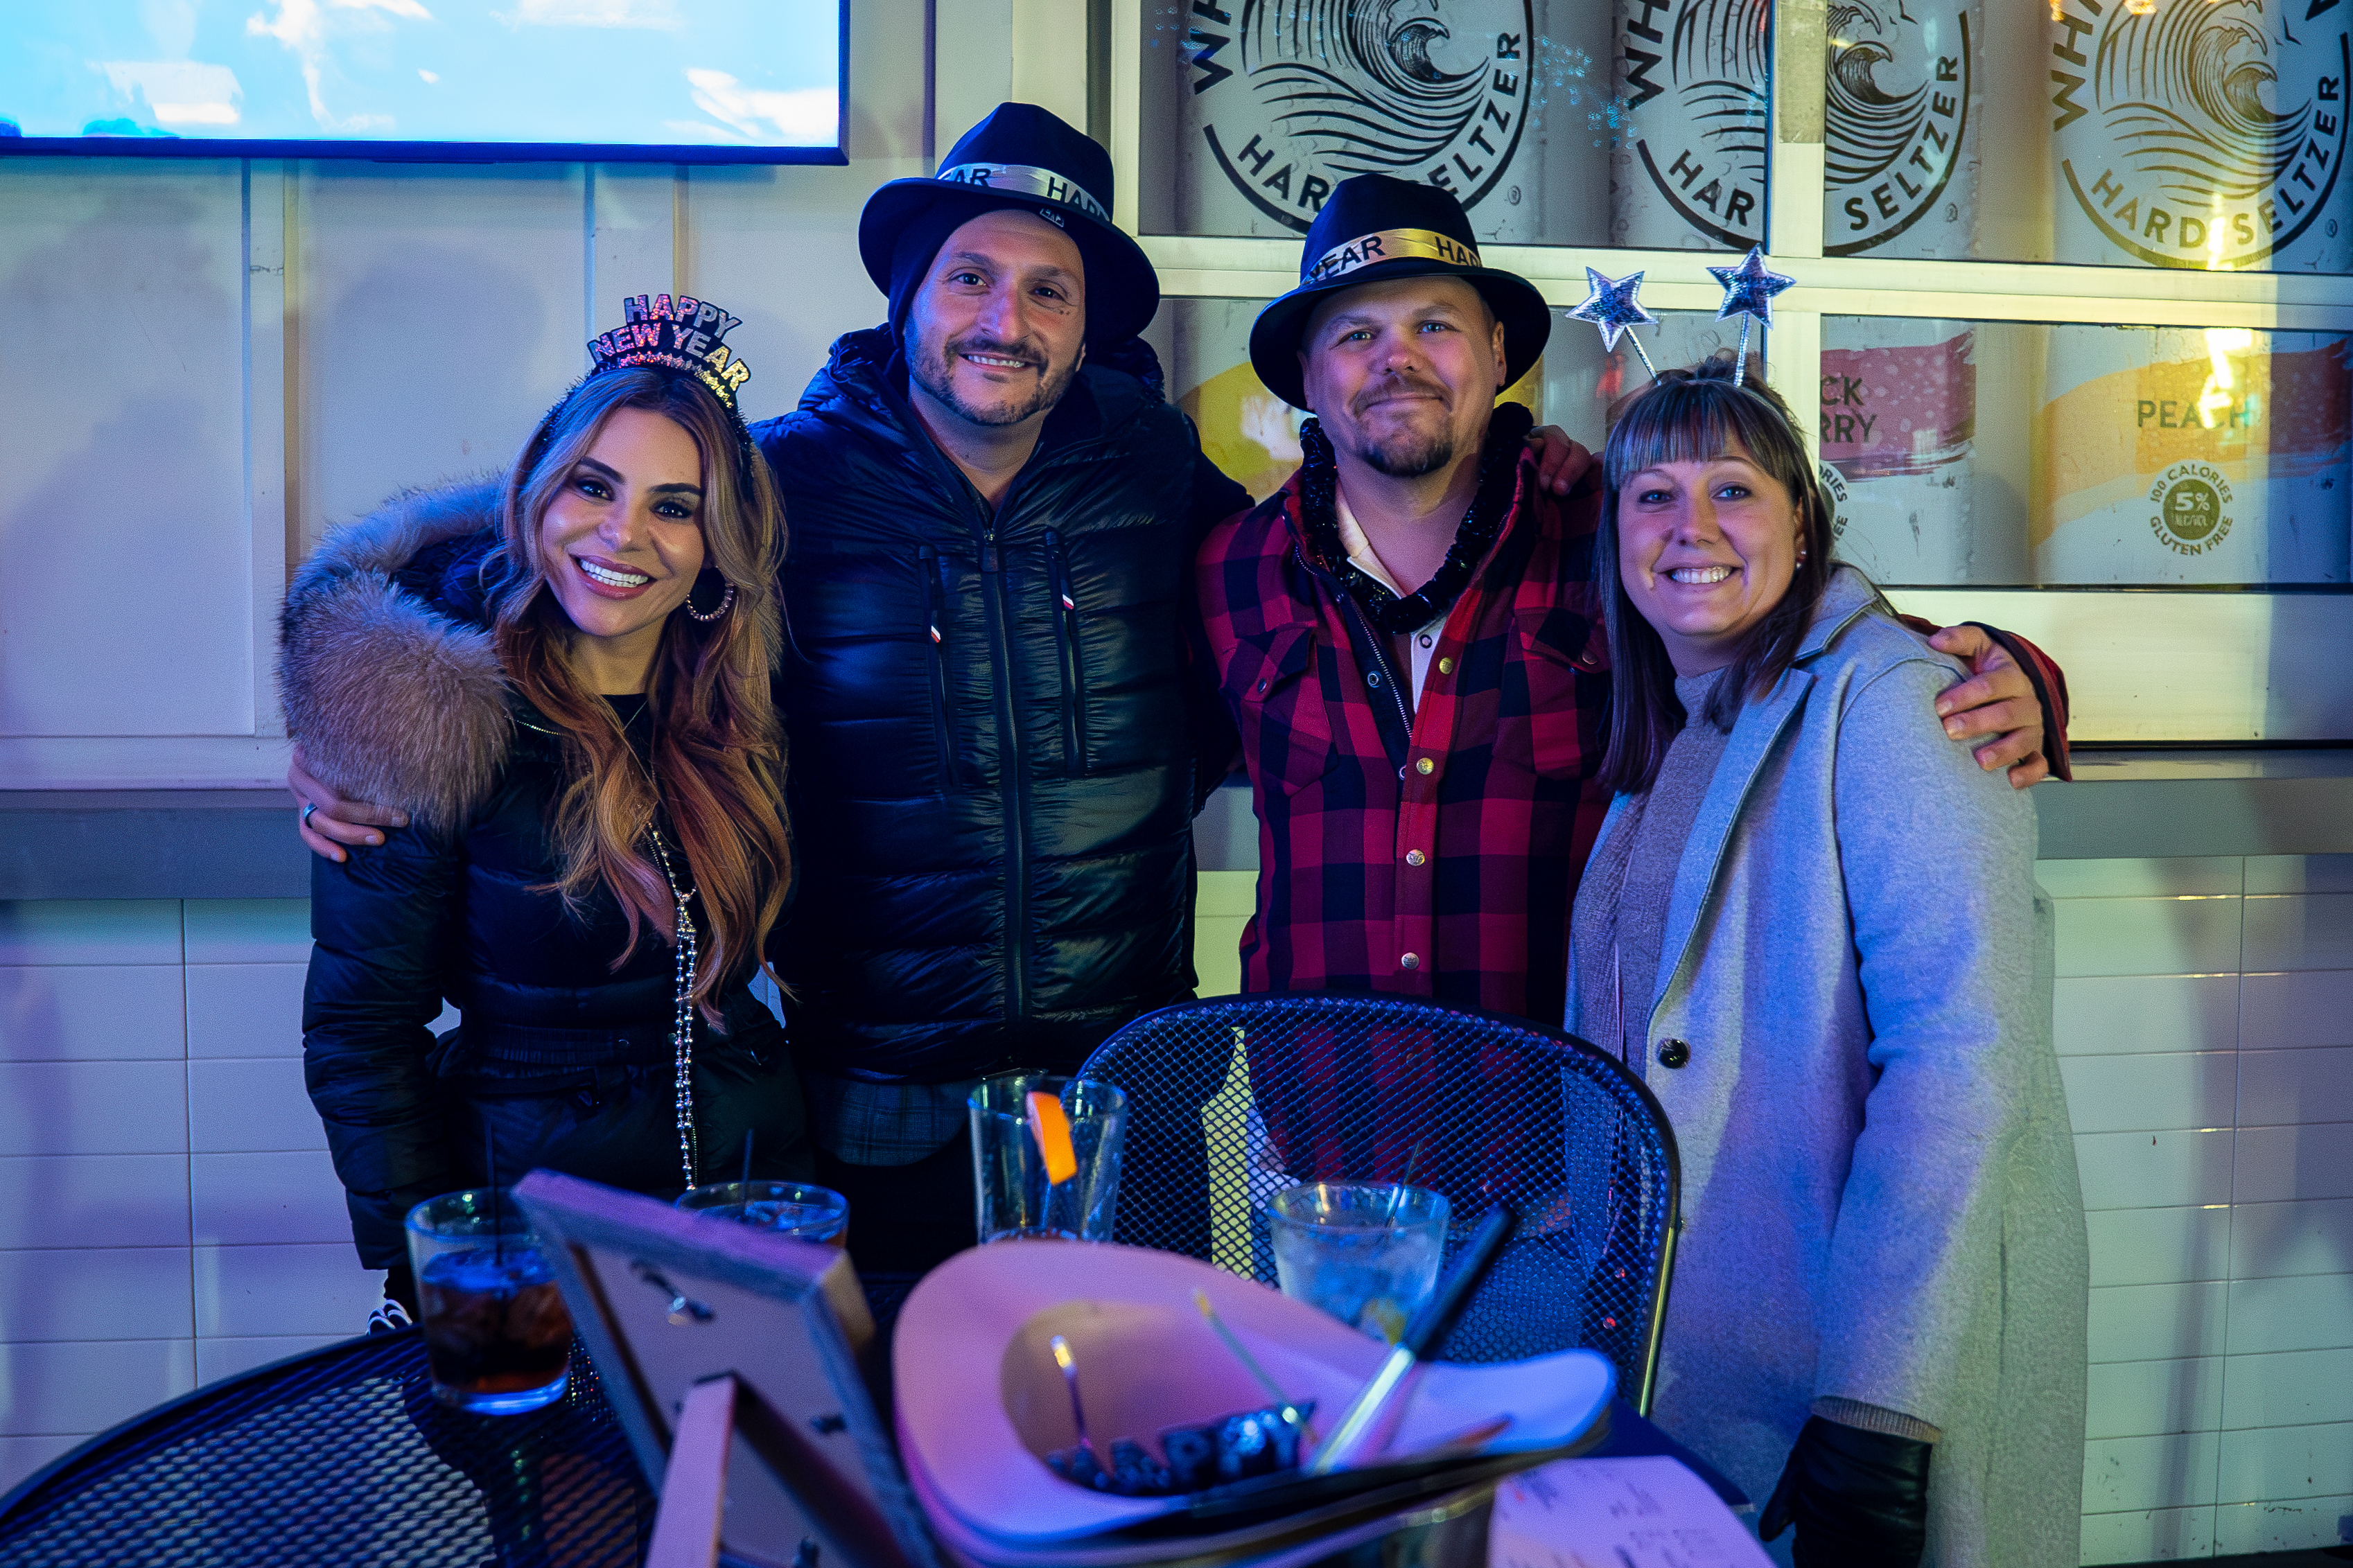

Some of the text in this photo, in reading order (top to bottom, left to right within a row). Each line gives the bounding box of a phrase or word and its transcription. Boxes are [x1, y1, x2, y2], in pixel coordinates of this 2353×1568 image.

[1426, 32, 1521, 195] ELTZER
[1844, 56, 1958, 231] SELTZER
[2091, 76, 2339, 249] HARD SELTZER
[943, 168, 991, 187] AR
[624, 294, 743, 338] HAPPY
[588, 322, 751, 391] NEW YEAR
[2150, 464, 2233, 504] 100 CALORIES
[2175, 491, 2211, 511] 5%
[2150, 515, 2233, 556] GLUTEN FREE
